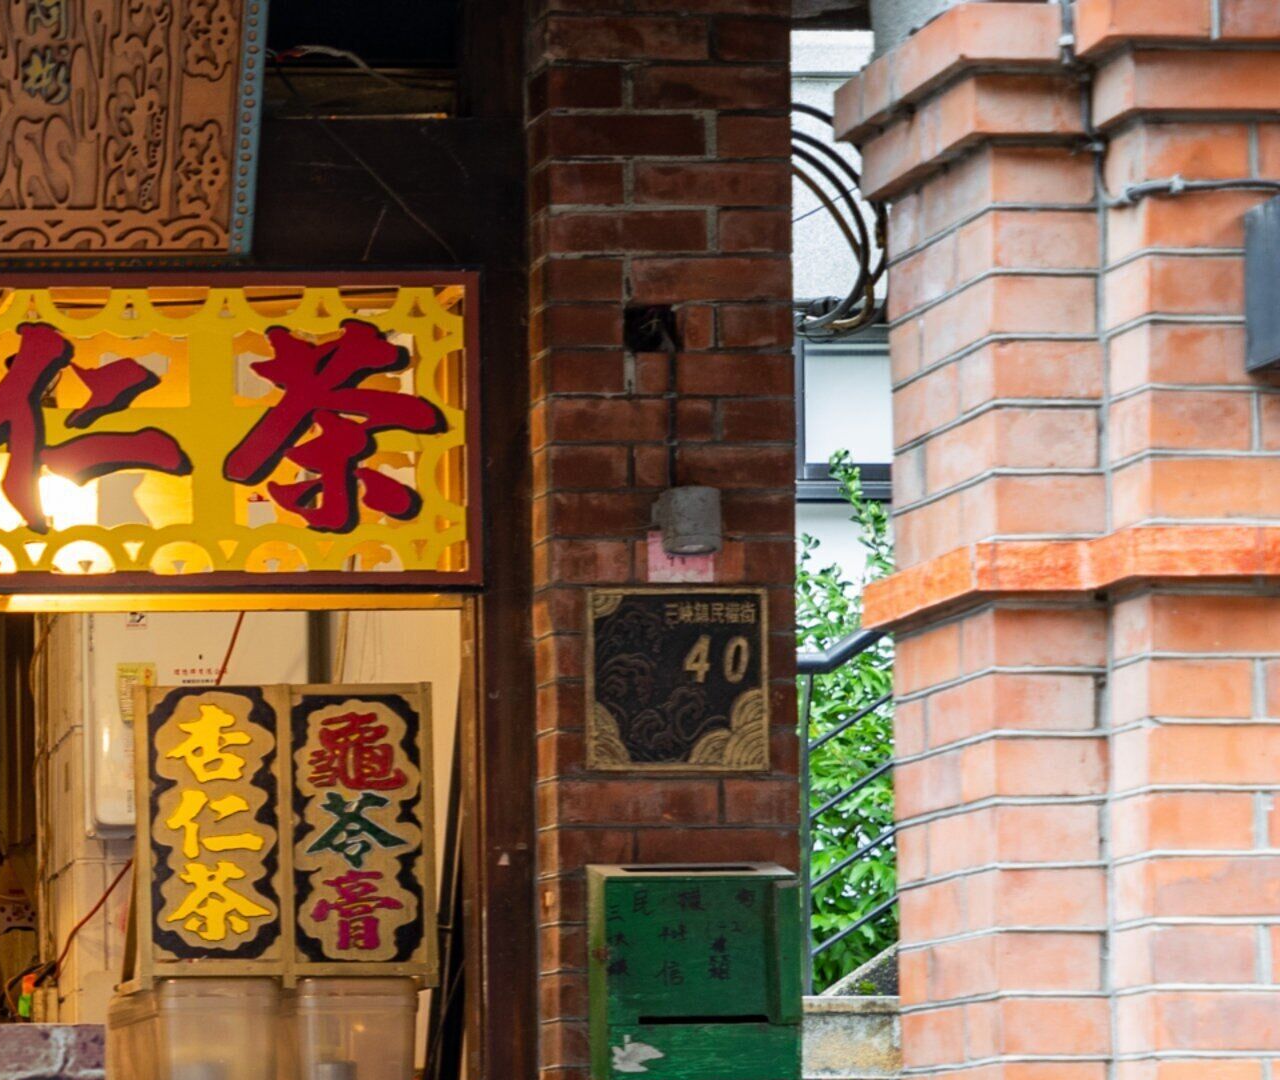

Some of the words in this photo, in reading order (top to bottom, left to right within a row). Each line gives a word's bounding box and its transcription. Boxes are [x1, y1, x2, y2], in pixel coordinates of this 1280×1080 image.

[682, 633, 750, 684] 40
[165, 702, 272, 941] 杏仁茶
[306, 711, 409, 951] 龜苓膏
